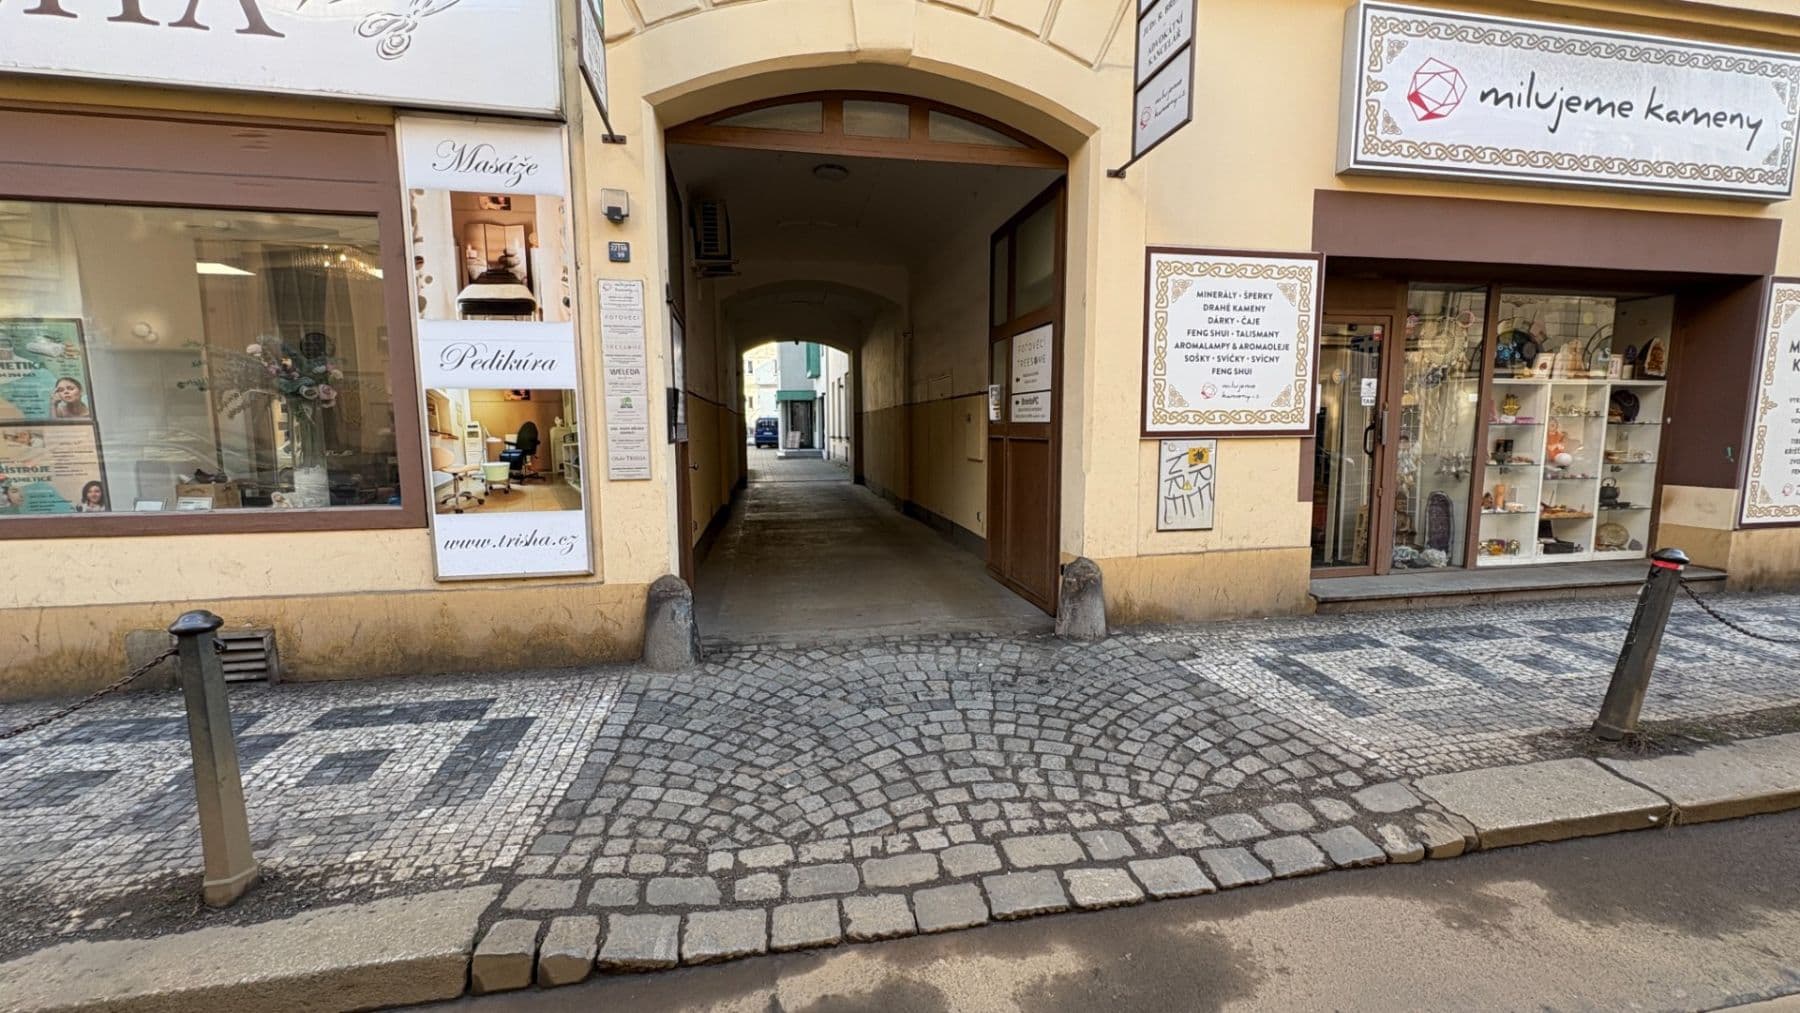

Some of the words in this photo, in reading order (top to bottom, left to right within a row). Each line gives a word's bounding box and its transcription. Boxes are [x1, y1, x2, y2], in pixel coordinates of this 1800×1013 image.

[1480, 71, 1633, 133] milujeme
[1645, 86, 1763, 151] kameny
[432, 140, 539, 187] Masáže
[1196, 290, 1237, 299] MINERÁLY
[1244, 290, 1273, 300] ŠPERKY
[1203, 303, 1230, 312] DRAHÉ
[1233, 304, 1266, 313] KAMENY
[1208, 315, 1235, 325] DÁRKY
[1241, 315, 1260, 325] ČAJE
[1187, 329, 1208, 337] FENG
[1210, 329, 1229, 337] SHUI
[1236, 330, 1280, 338] TALISMANY
[1174, 342, 1230, 350] AROMALAMPY
[1239, 343, 1290, 351] AROMAOLEJE
[440, 342, 556, 371] Pedikúra
[1184, 353, 1210, 362] SOŠKY
[1217, 353, 1245, 363] SVÍČKY
[1211, 367, 1232, 375] FENG
[1234, 367, 1253, 375] SHUI
[444, 529, 579, 555] www.trisha.cz
